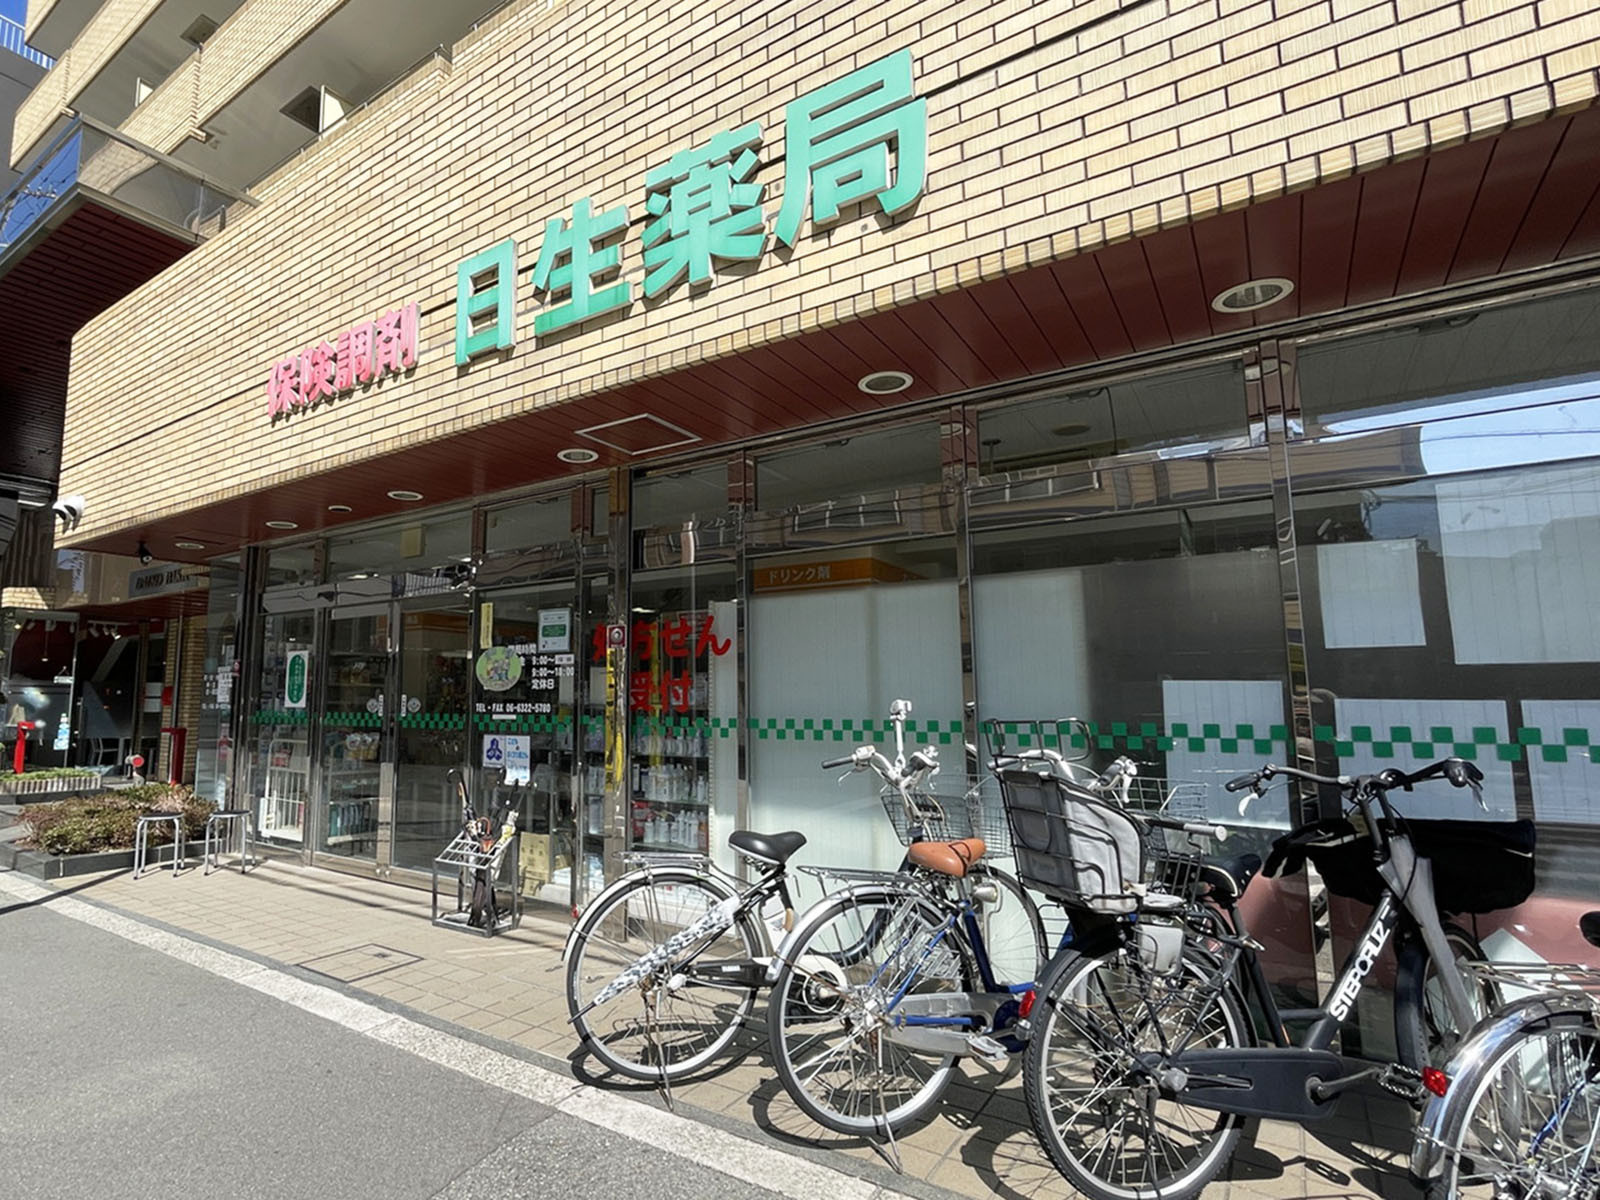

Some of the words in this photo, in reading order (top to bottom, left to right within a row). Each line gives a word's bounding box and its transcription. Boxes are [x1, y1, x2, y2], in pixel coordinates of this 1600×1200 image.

[455, 48, 927, 366] 日生薬局
[267, 301, 421, 417] 保険調剤
[1329, 920, 1391, 1022] STEPCRUZ
